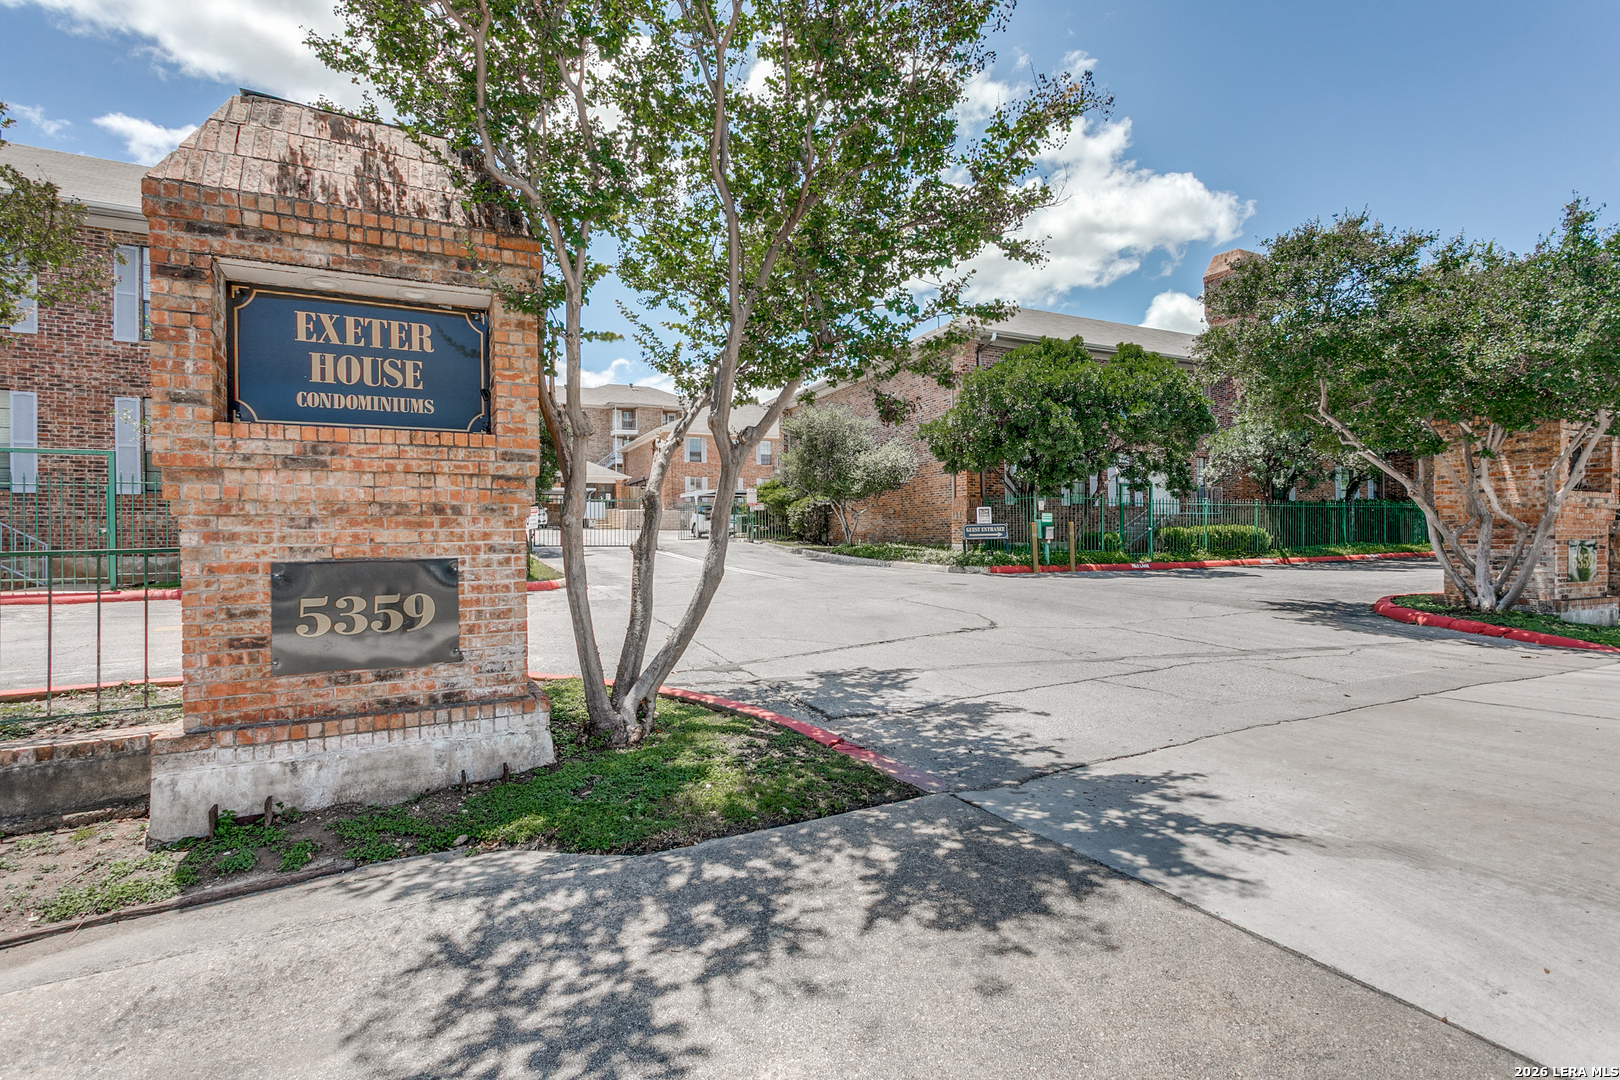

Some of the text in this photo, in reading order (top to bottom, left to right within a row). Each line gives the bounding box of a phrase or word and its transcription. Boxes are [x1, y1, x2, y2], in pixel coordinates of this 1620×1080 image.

[294, 310, 435, 353] EXETER
[308, 352, 423, 390] HOUSE
[296, 391, 435, 414] CONDOMINIUMS
[1572, 554, 1594, 569] 5359
[295, 592, 436, 638] 5359
